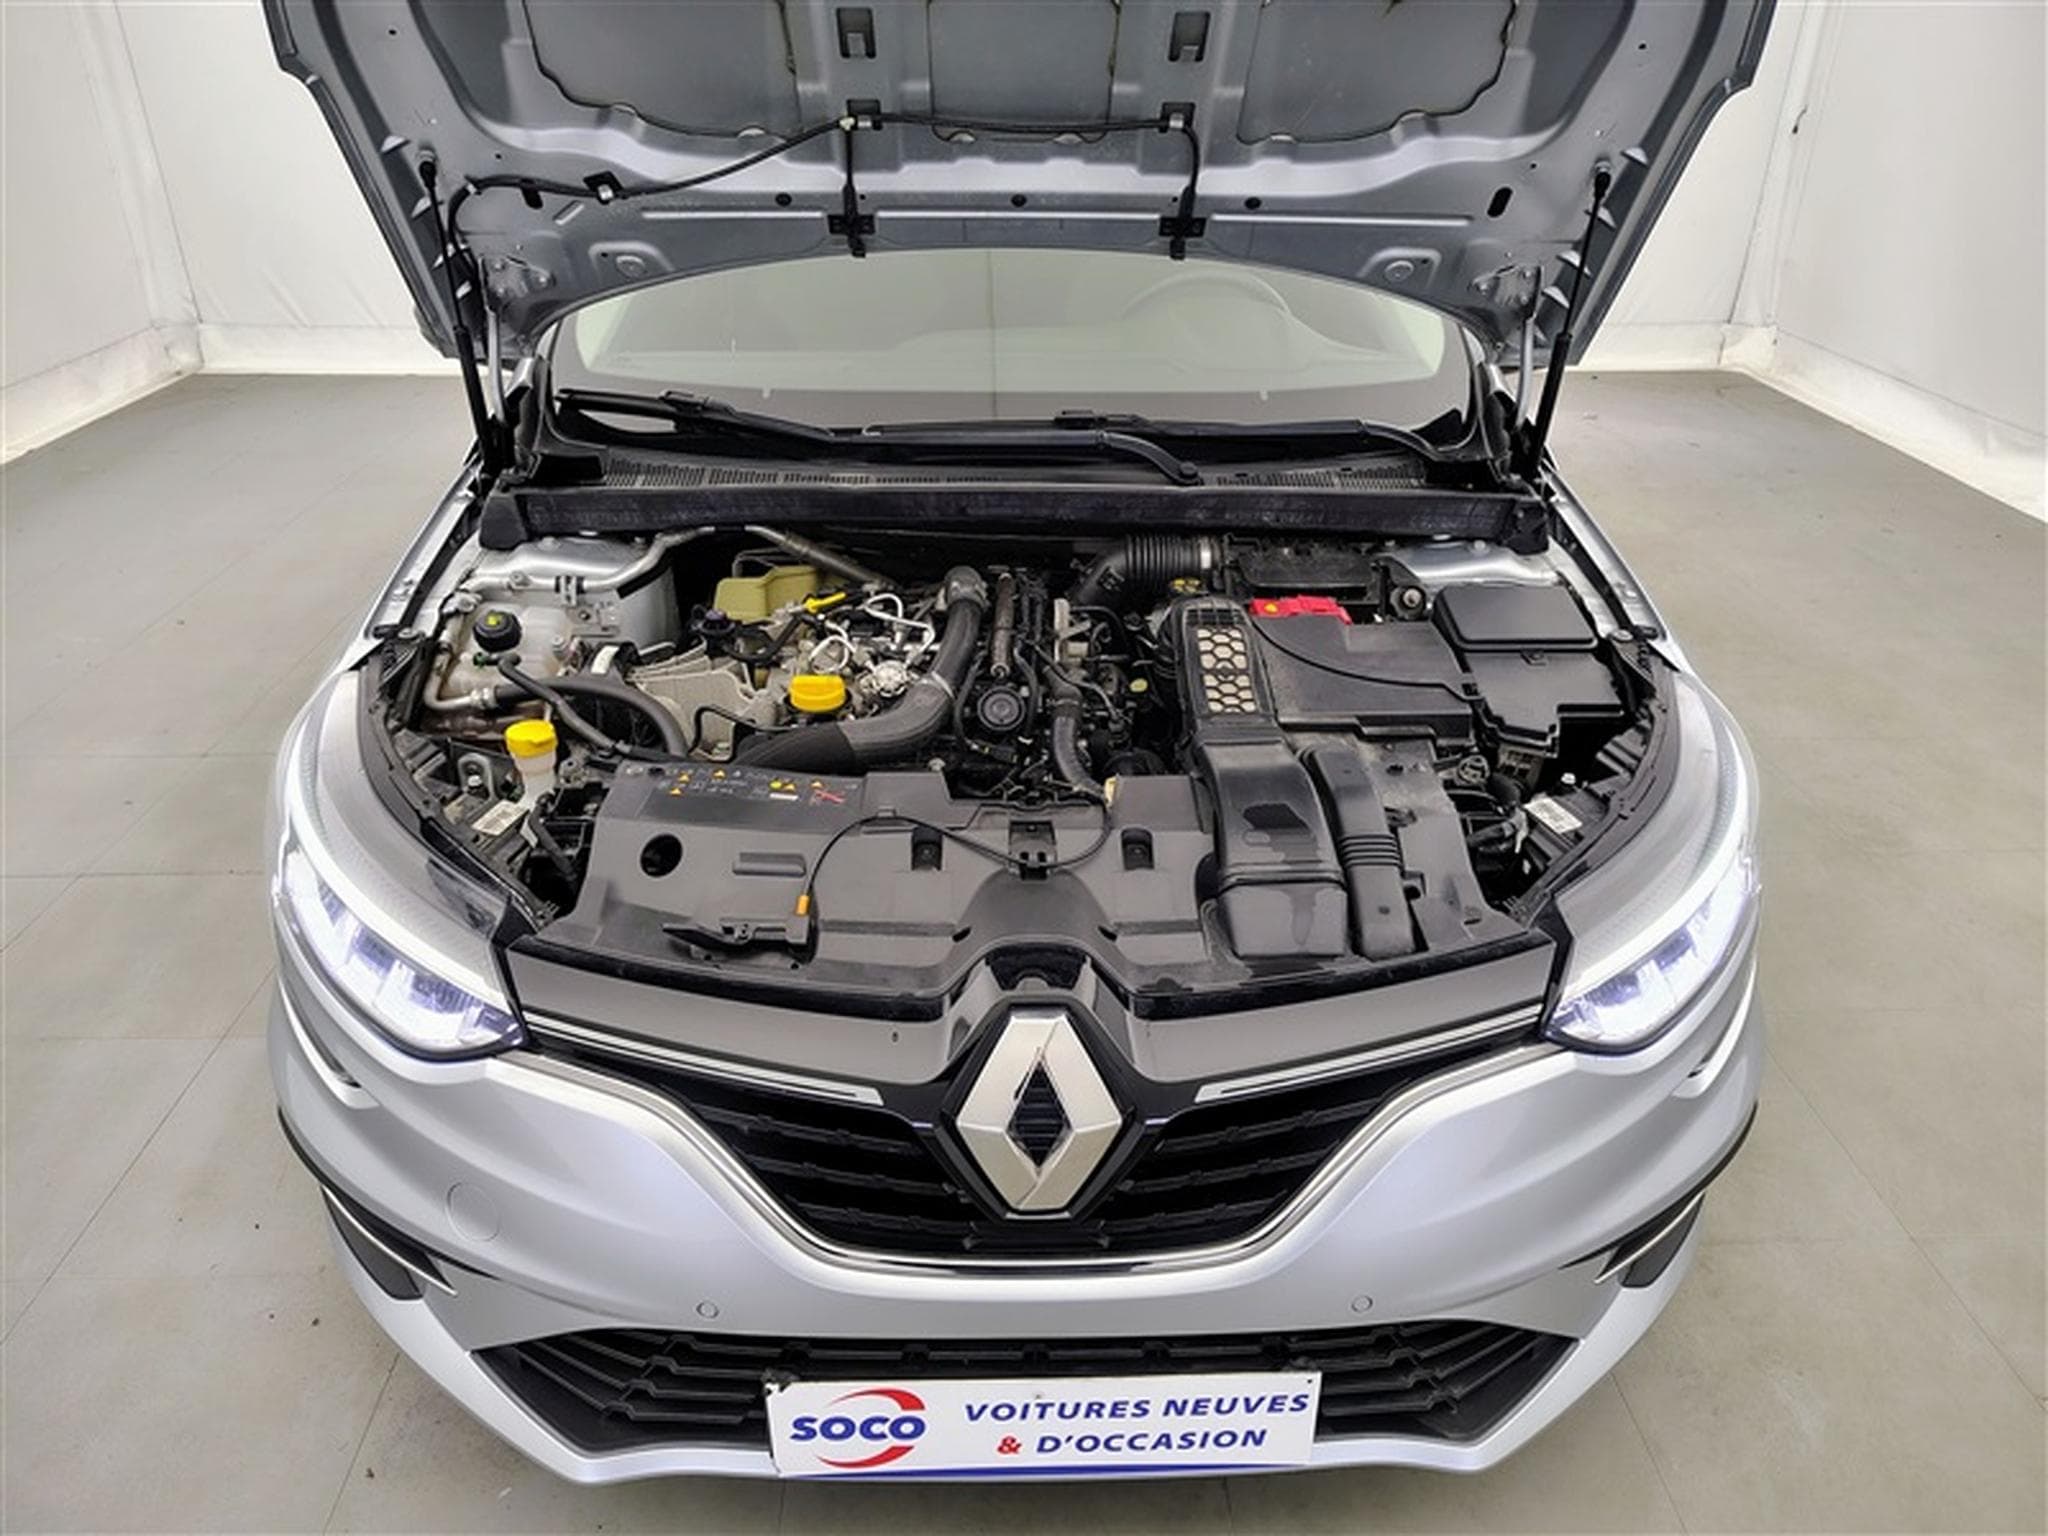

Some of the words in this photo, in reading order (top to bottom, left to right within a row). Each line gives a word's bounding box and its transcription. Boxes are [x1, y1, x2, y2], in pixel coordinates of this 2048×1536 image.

[966, 1399, 1150, 1422] VOITURES
[1162, 1393, 1310, 1418] NEUVES
[790, 1415, 926, 1442] SOCO
[997, 1435, 1022, 1455] &
[1036, 1428, 1267, 1454] D'OCCASION
